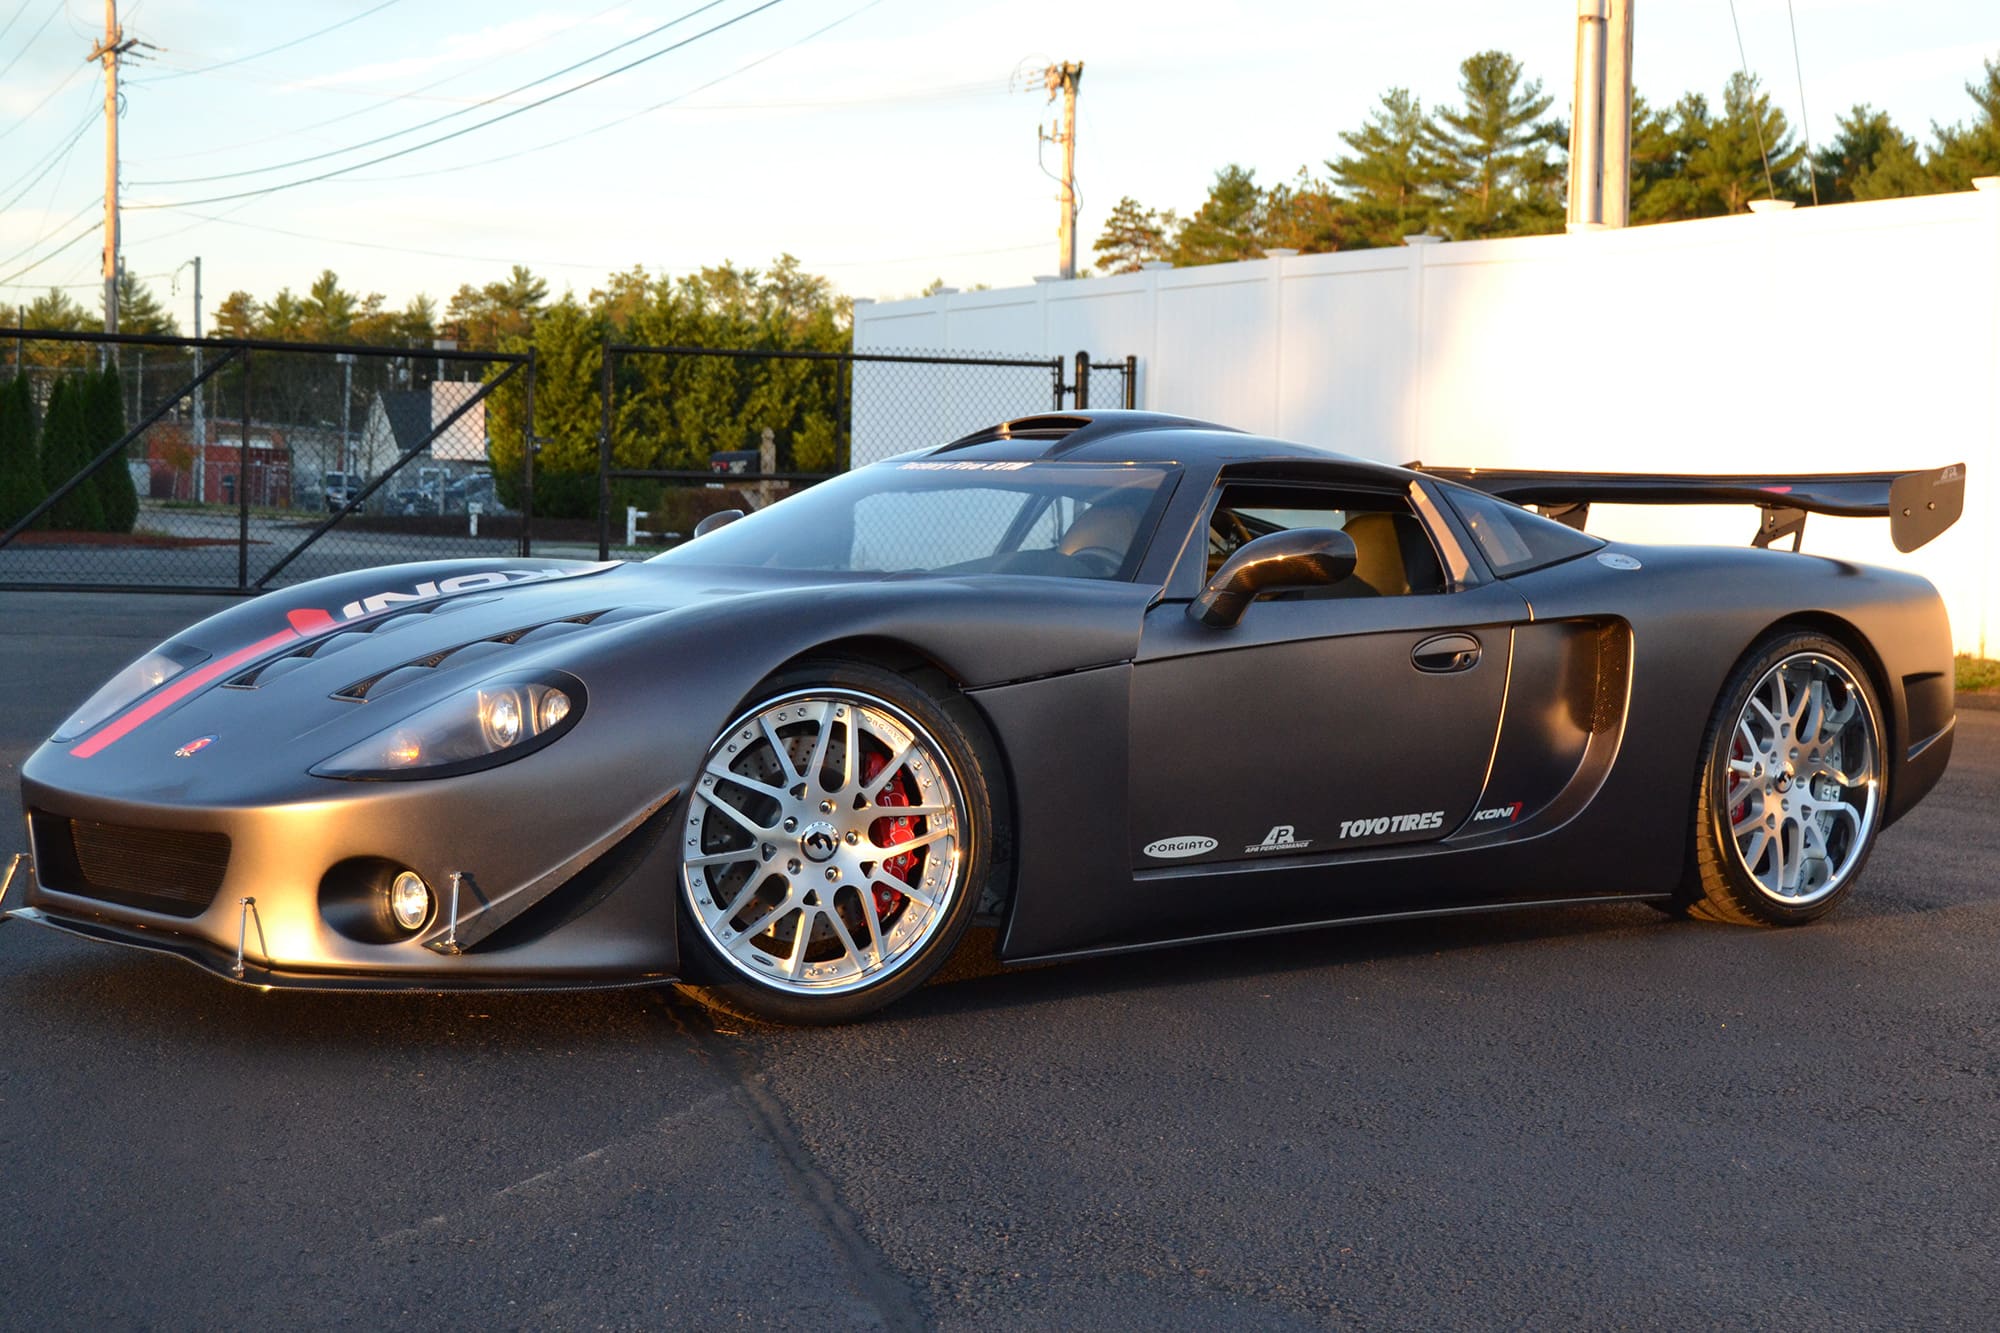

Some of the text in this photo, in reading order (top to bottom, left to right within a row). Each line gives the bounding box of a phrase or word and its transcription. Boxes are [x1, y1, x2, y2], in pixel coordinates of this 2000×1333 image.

[1474, 806, 1514, 821] KONI
[1339, 811, 1444, 839] TOYO TIRES
[1149, 840, 1214, 853] FORGIATO
[1260, 841, 1310, 851] PERFORMANCE
